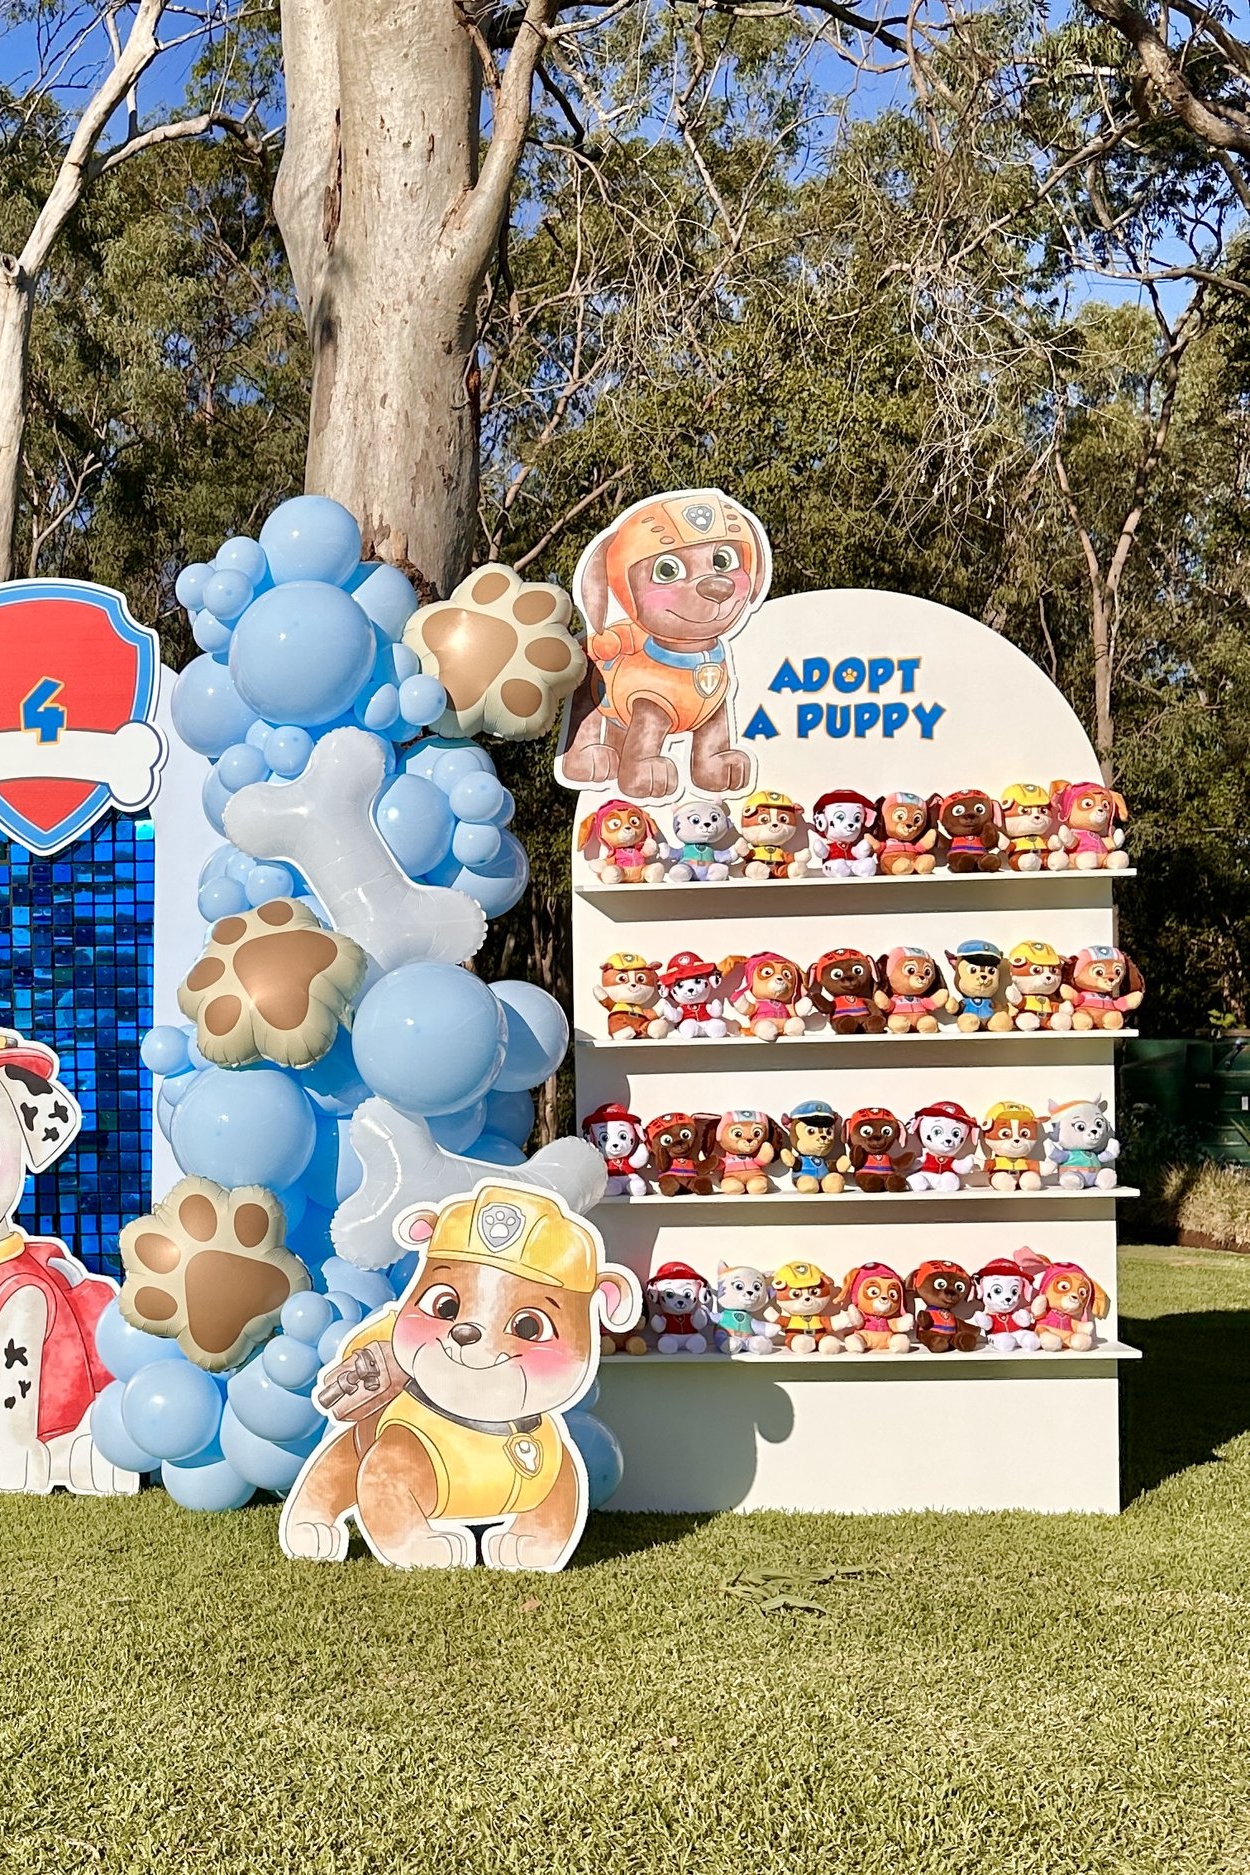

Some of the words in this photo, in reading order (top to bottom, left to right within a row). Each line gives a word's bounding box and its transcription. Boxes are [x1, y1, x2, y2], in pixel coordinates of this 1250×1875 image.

[768, 657, 921, 693] ADOPT
[20, 676, 67, 745] 4
[742, 704, 781, 740] A
[797, 702, 946, 740] PUPPY
